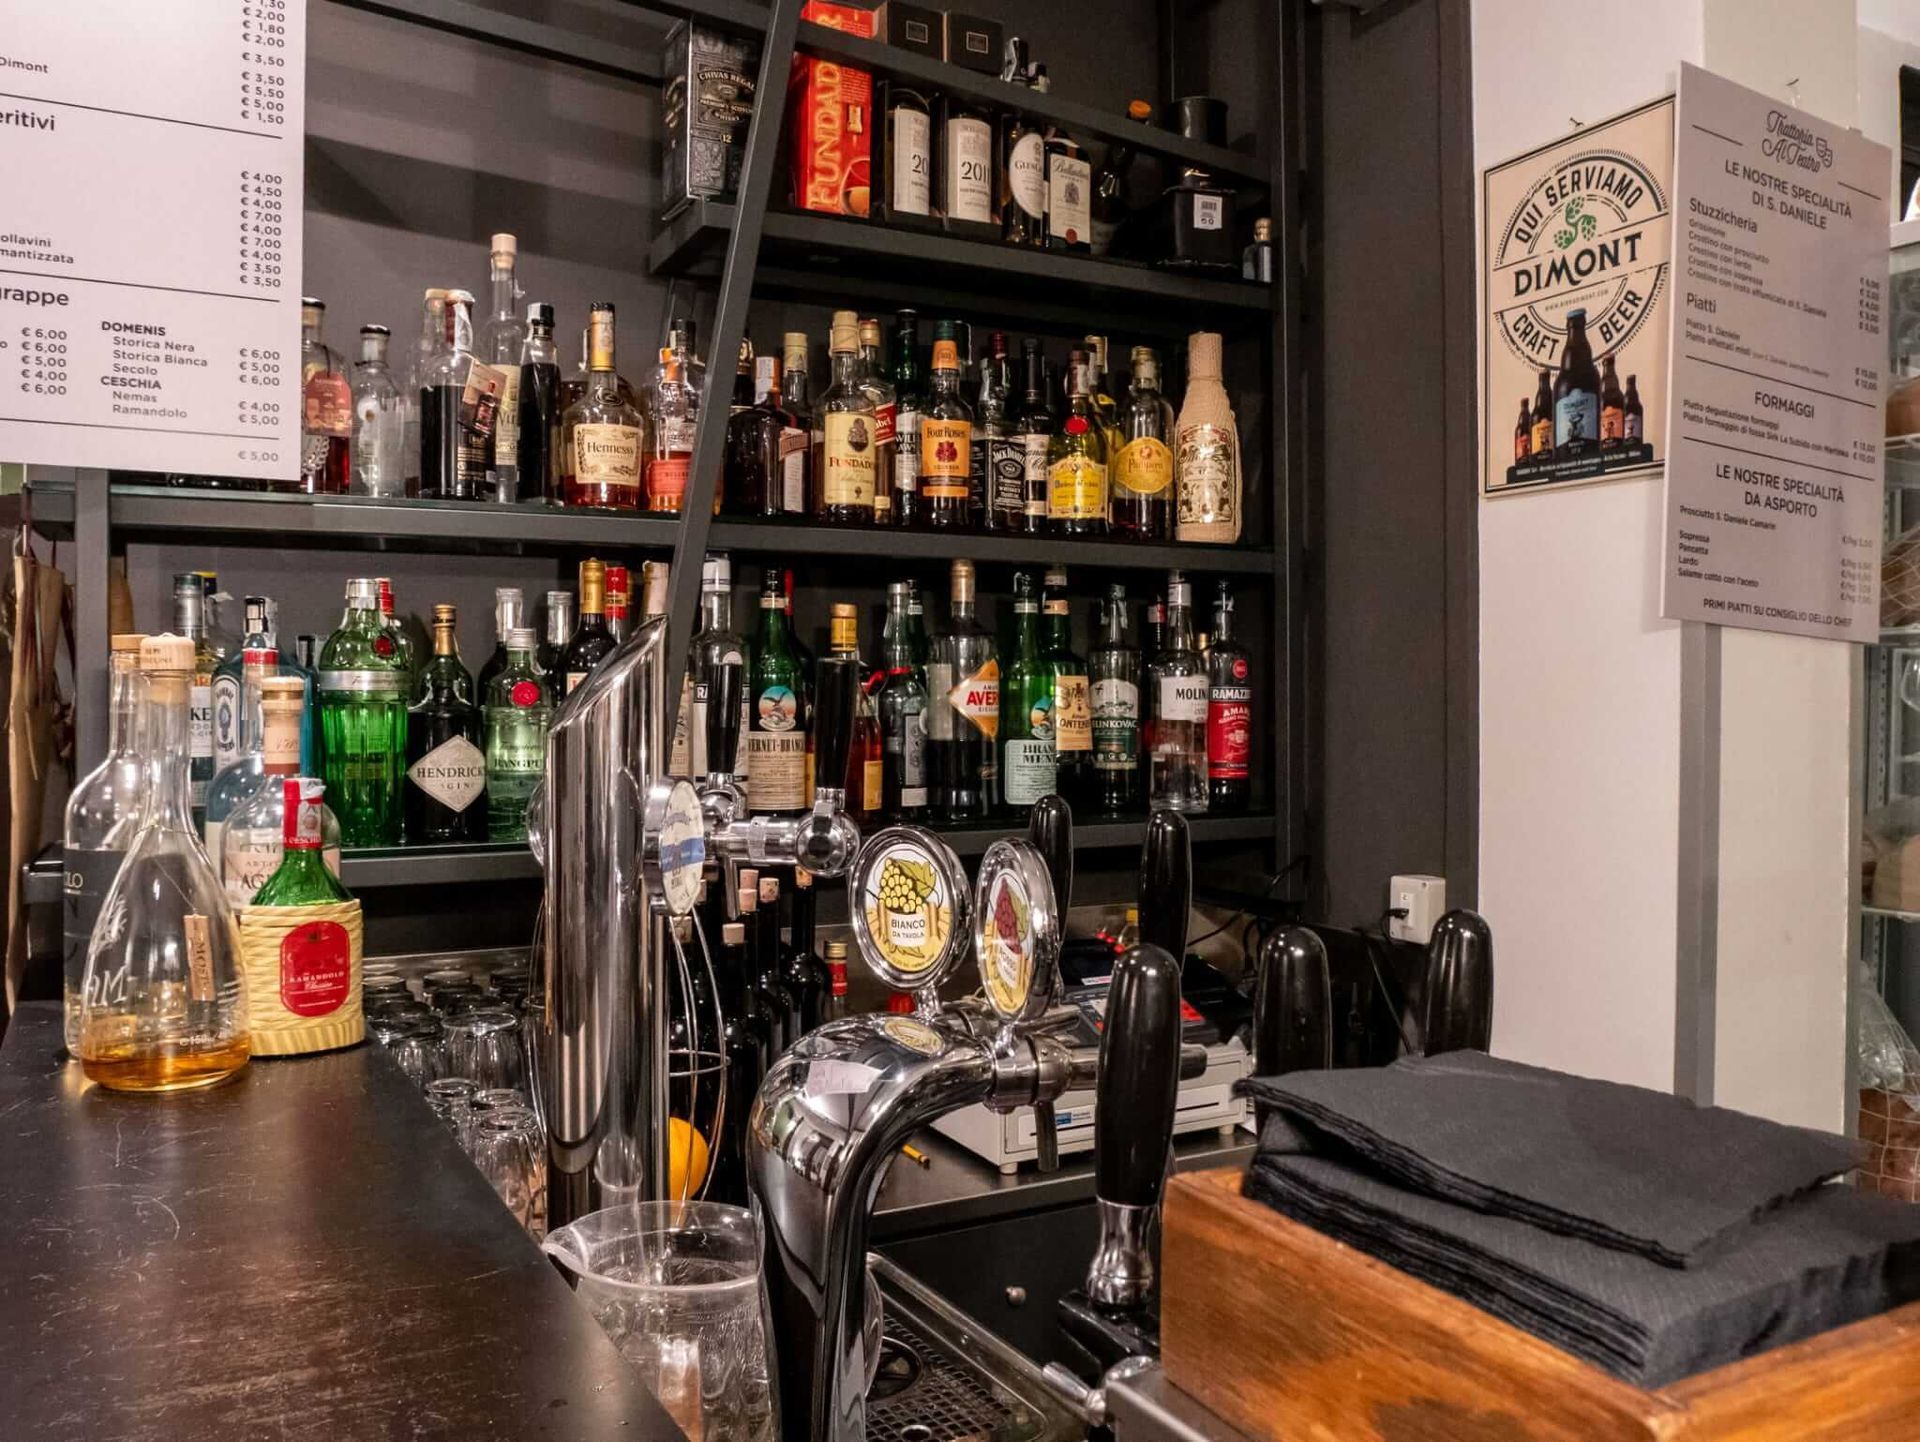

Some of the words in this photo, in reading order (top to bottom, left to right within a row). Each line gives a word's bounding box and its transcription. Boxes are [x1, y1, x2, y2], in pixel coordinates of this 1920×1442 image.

[243, 7, 250, 16] €
[242, 20, 250, 29] €
[242, 32, 250, 42] €
[242, 52, 250, 60] €
[242, 72, 250, 80] €
[699, 72, 728, 80] CHIVAS
[242, 84, 250, 93] €
[242, 97, 250, 106] €
[241, 110, 250, 119] €
[241, 171, 249, 180] €
[241, 184, 249, 192] €
[1725, 160, 1740, 176] LE
[1742, 166, 1788, 195] NOSTRE
[1791, 186, 1852, 218] SPECIALITÀ
[240, 197, 248, 206] €
[1514, 203, 1544, 244] QUI
[1545, 166, 1644, 210] SERVIAMO
[240, 210, 248, 219] €
[1752, 191, 1765, 208] DI
[1780, 201, 1828, 230] DANIELE
[1690, 198, 1758, 233] Stuzzicheria
[240, 223, 248, 232] €
[0, 234, 52, 248] ollavini
[240, 236, 248, 244] €
[240, 249, 248, 258] €
[240, 262, 248, 270] €
[1514, 231, 1643, 297] DIMONT
[240, 275, 248, 284] €
[0, 287, 69, 307] rappe
[1687, 292, 1716, 314] Piatti
[101, 321, 166, 336] DOMENIS
[1513, 313, 1560, 360] CRAFT
[1599, 290, 1644, 344] BEER
[22, 327, 30, 336] €
[22, 342, 30, 350] €
[113, 336, 160, 350] Storica
[165, 341, 195, 352] Nera
[240, 348, 248, 357] €
[21, 356, 30, 364] €
[113, 350, 160, 364] Storica
[164, 354, 208, 367] Bianca
[112, 364, 158, 376] Secolo
[240, 362, 247, 370] €
[21, 369, 30, 378] €
[100, 376, 162, 390] CESCHIA
[240, 374, 247, 383] €
[21, 383, 30, 392] €
[112, 391, 158, 403] Nemas
[239, 401, 247, 410] €
[1754, 391, 1815, 419] FORMAGGI
[112, 404, 188, 418] Ramandolo
[239, 414, 246, 422] €
[238, 451, 246, 460] €
[1716, 464, 1730, 480] LE
[1734, 468, 1780, 490] NOSTRE
[1783, 478, 1845, 502] SPECIALITÀ
[1744, 492, 1761, 507] DA
[1764, 496, 1818, 518] ASPORTO
[1703, 598, 1726, 610] PRIMI
[1727, 601, 1752, 612] PIATTI
[1754, 605, 1764, 616] SU
[1766, 606, 1807, 622] CONSIGLIO
[1808, 612, 1832, 625] DELLO
[891, 918, 926, 930] BIANCO
